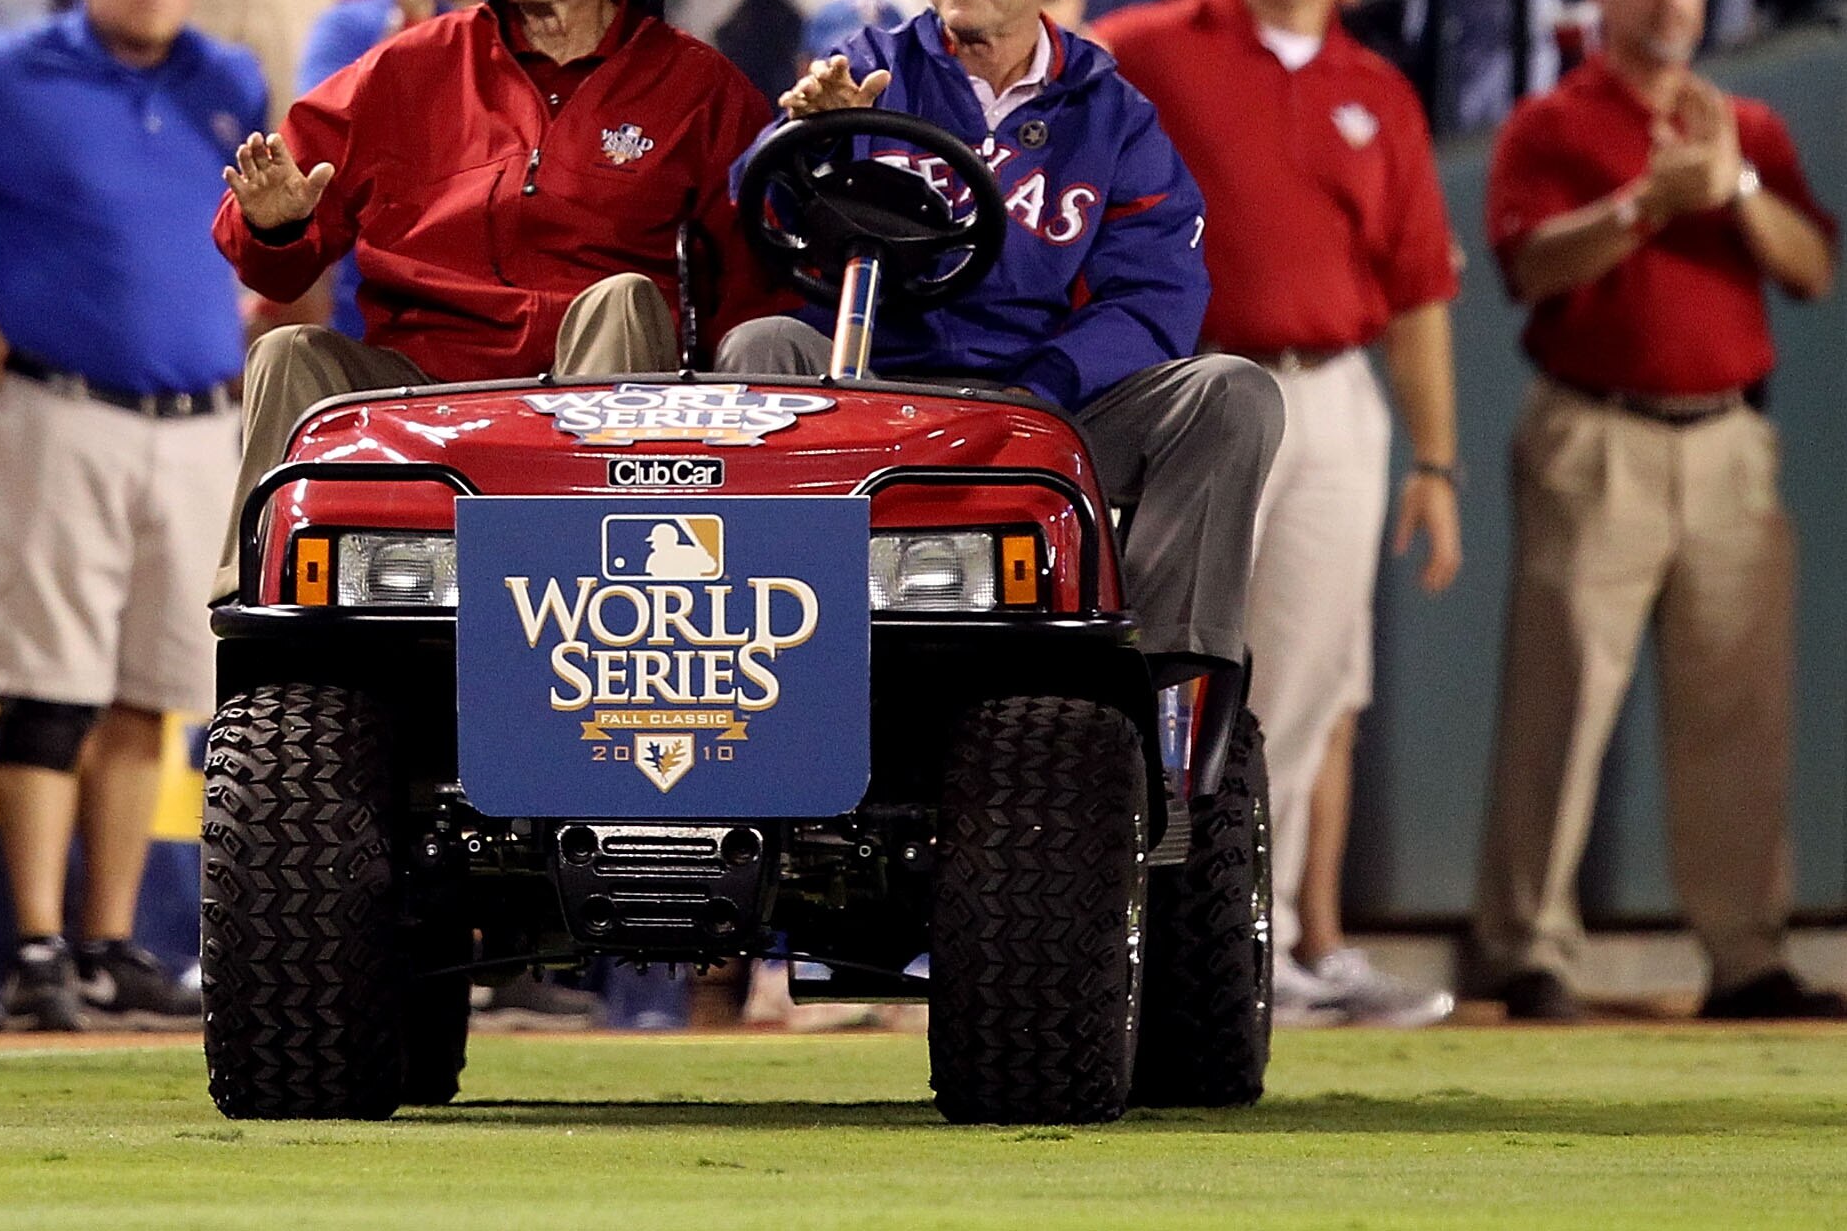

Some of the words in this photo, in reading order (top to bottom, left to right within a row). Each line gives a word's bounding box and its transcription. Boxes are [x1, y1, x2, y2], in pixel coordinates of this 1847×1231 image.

[521, 392, 837, 413] WORLD
[559, 408, 796, 430] SERIES
[614, 461, 670, 486] Club
[673, 462, 717, 486] Car
[503, 576, 819, 648] WORLD
[550, 641, 781, 711] SERIES
[600, 713, 643, 725] FALL
[649, 713, 728, 725] CLASSIC
